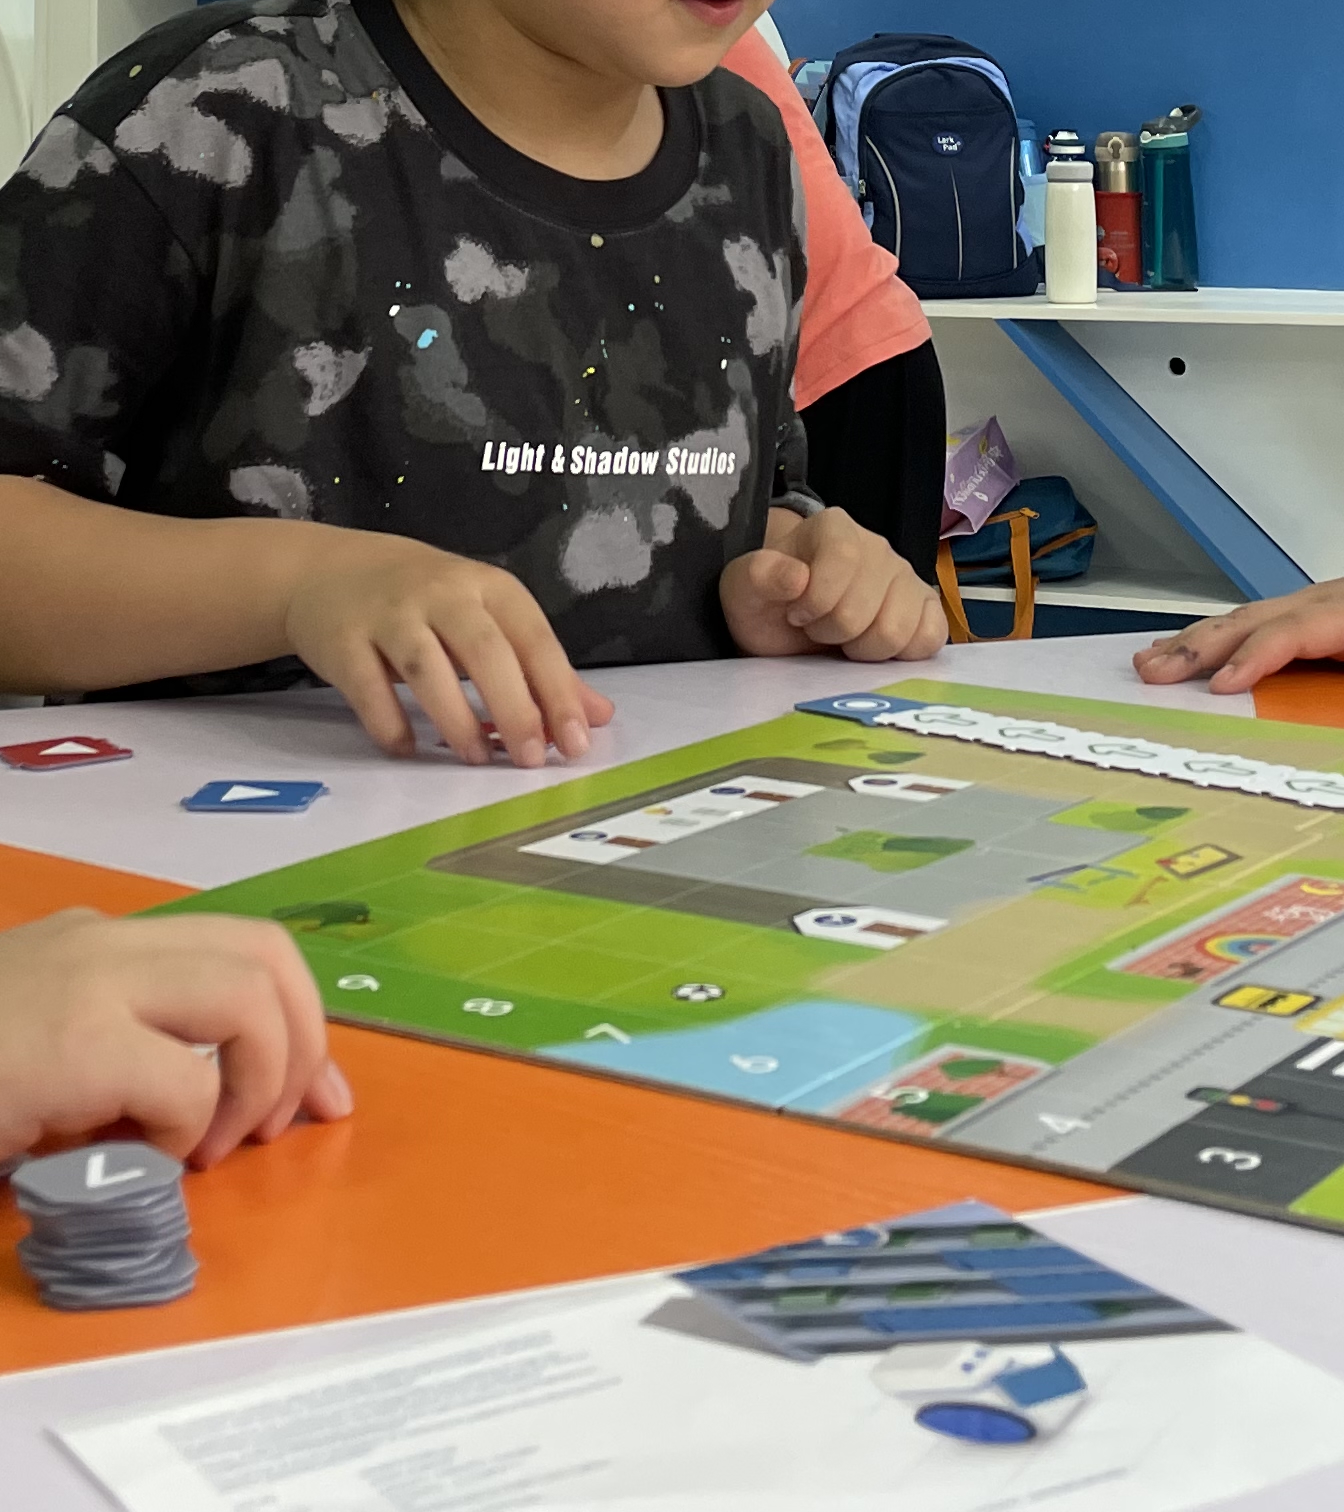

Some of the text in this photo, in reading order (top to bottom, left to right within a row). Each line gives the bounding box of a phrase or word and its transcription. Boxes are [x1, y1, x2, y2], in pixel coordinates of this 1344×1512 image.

[481, 441, 736, 476] Light & Shadow Studios
[463, 997, 514, 1017] 8
[1197, 1146, 1262, 1171] 3
